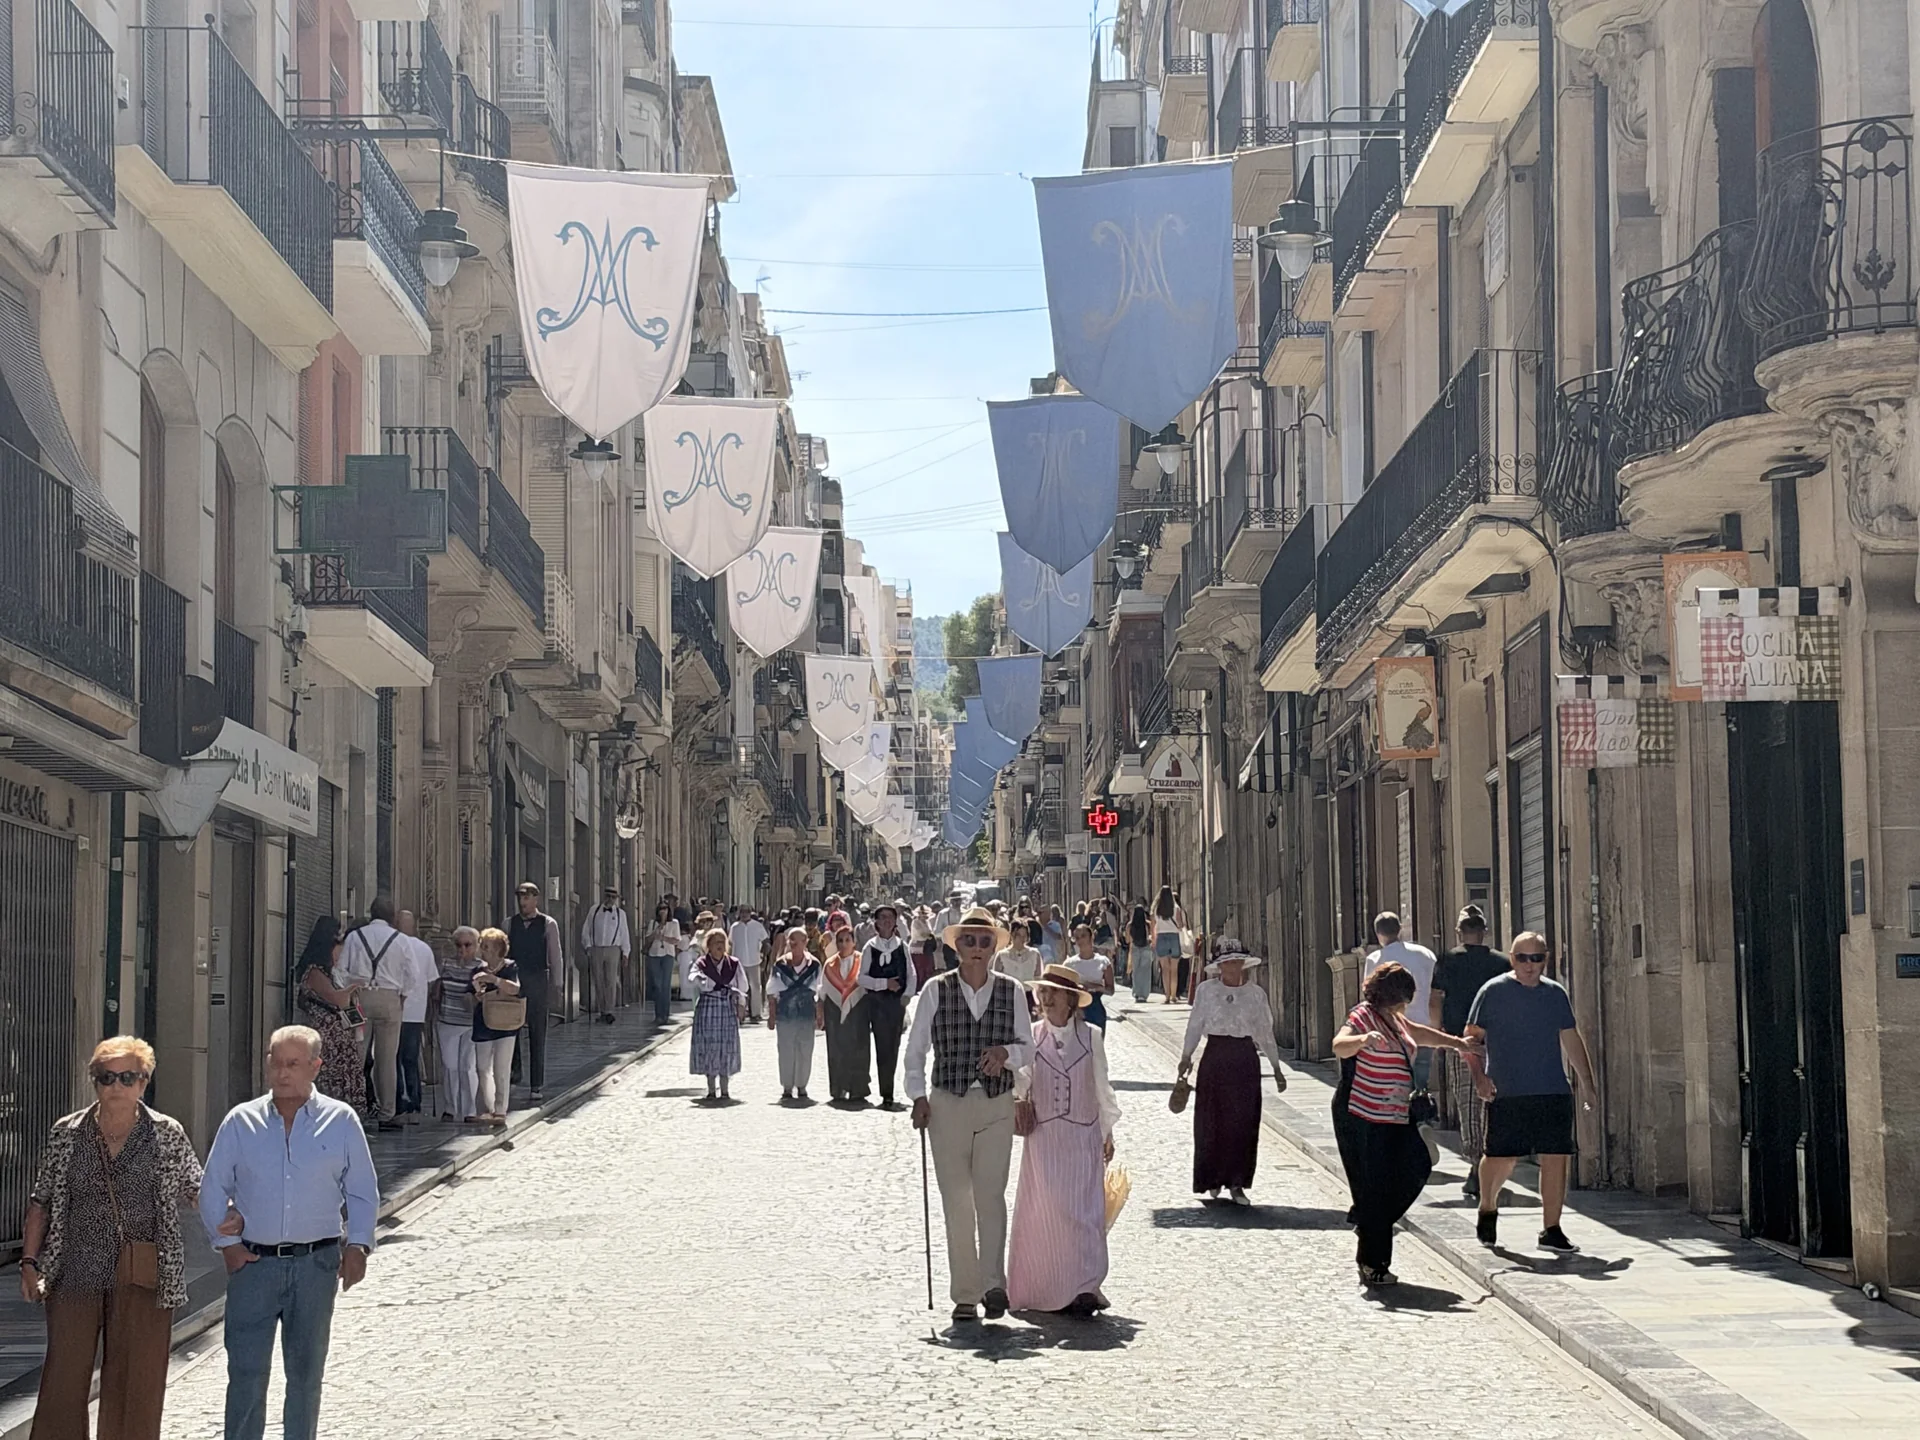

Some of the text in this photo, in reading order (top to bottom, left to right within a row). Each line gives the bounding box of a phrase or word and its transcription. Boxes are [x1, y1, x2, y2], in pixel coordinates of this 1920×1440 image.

[1726, 630, 1818, 658] COCINA
[1715, 660, 1830, 687] ITALIANA
[263, 759, 282, 800] Sant
[283, 769, 312, 812] Nicolau
[1148, 777, 1201, 788] Cruzcampo
